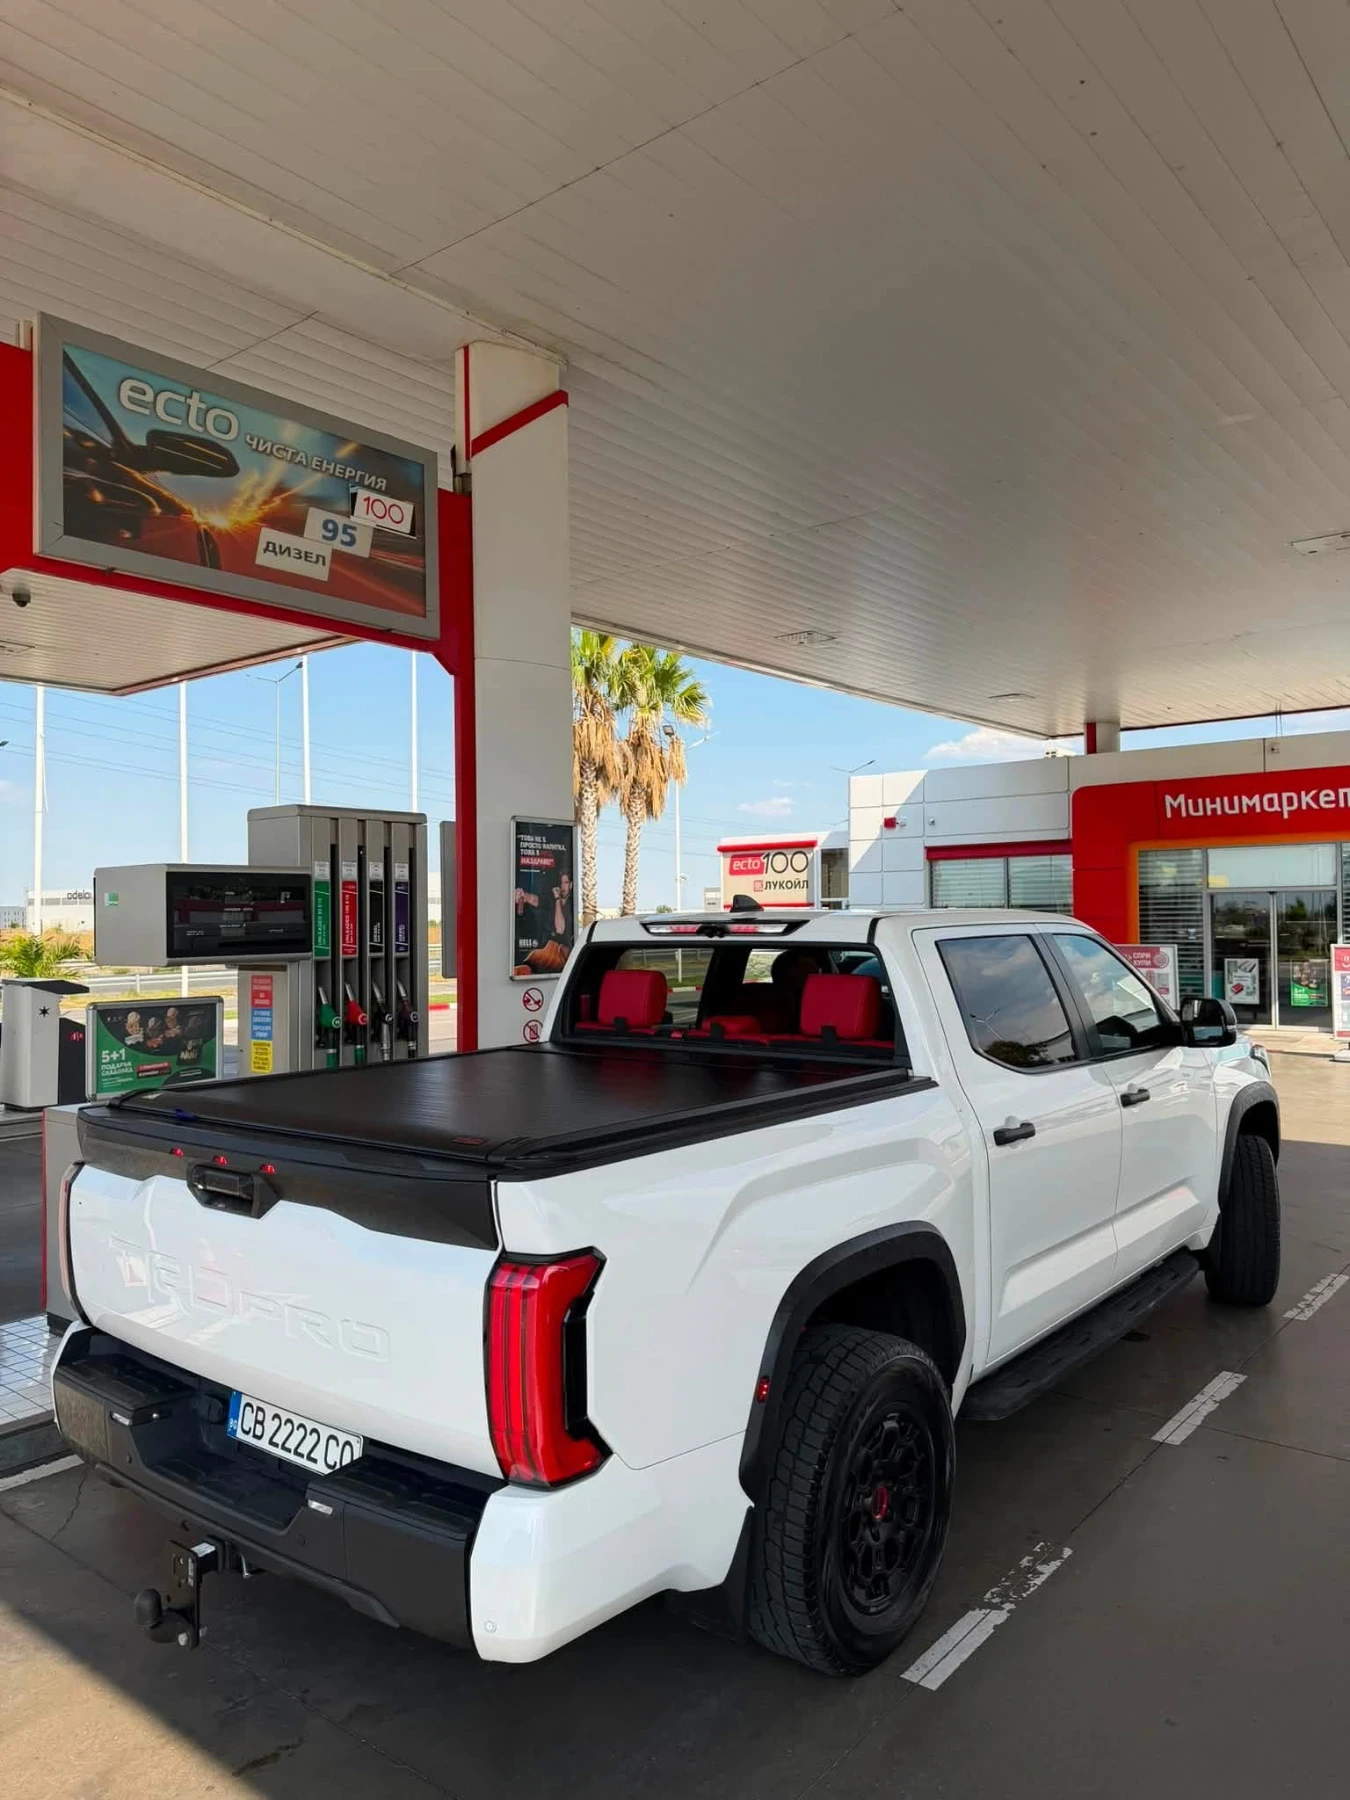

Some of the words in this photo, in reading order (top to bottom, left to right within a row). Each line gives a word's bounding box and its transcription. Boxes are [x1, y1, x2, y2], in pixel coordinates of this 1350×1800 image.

[119, 377, 239, 442] ecto
[245, 432, 309, 466] ЧИСТА
[310, 455, 388, 491] ЕНЕРГИЯ
[363, 496, 404, 524] 100
[322, 519, 358, 547] 95
[263, 541, 327, 567] ДИЗЕЛ
[733, 857, 761, 871] ecto
[762, 850, 809, 875] 100
[764, 878, 809, 891] ЛУКОЙЛ
[101, 1048, 126, 1063] 5+1
[238, 1288, 391, 1364] PRO
[241, 1401, 266, 1441] CB
[268, 1412, 321, 1465] 2222
